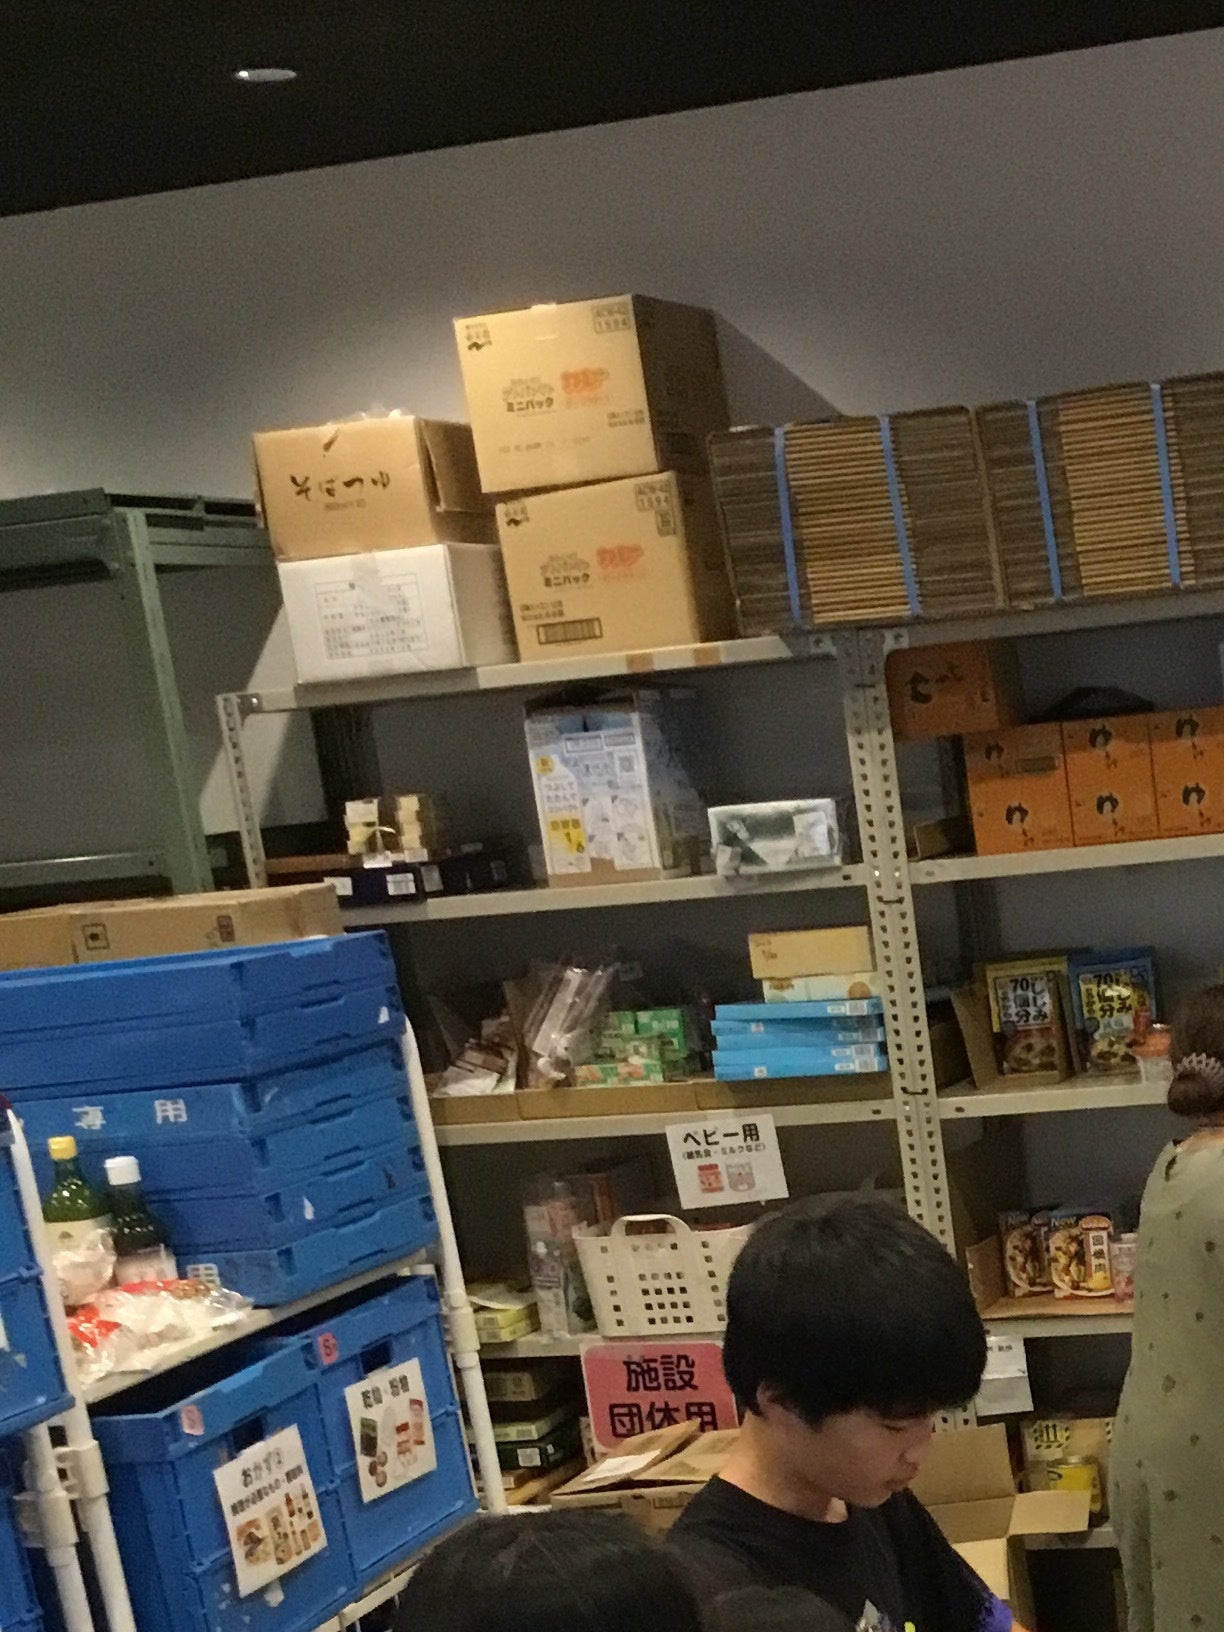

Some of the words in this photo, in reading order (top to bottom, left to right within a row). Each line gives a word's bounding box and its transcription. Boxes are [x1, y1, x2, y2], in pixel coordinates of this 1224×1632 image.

[683, 1123, 760, 1146] ベビー用
[623, 1354, 699, 1392] 施設
